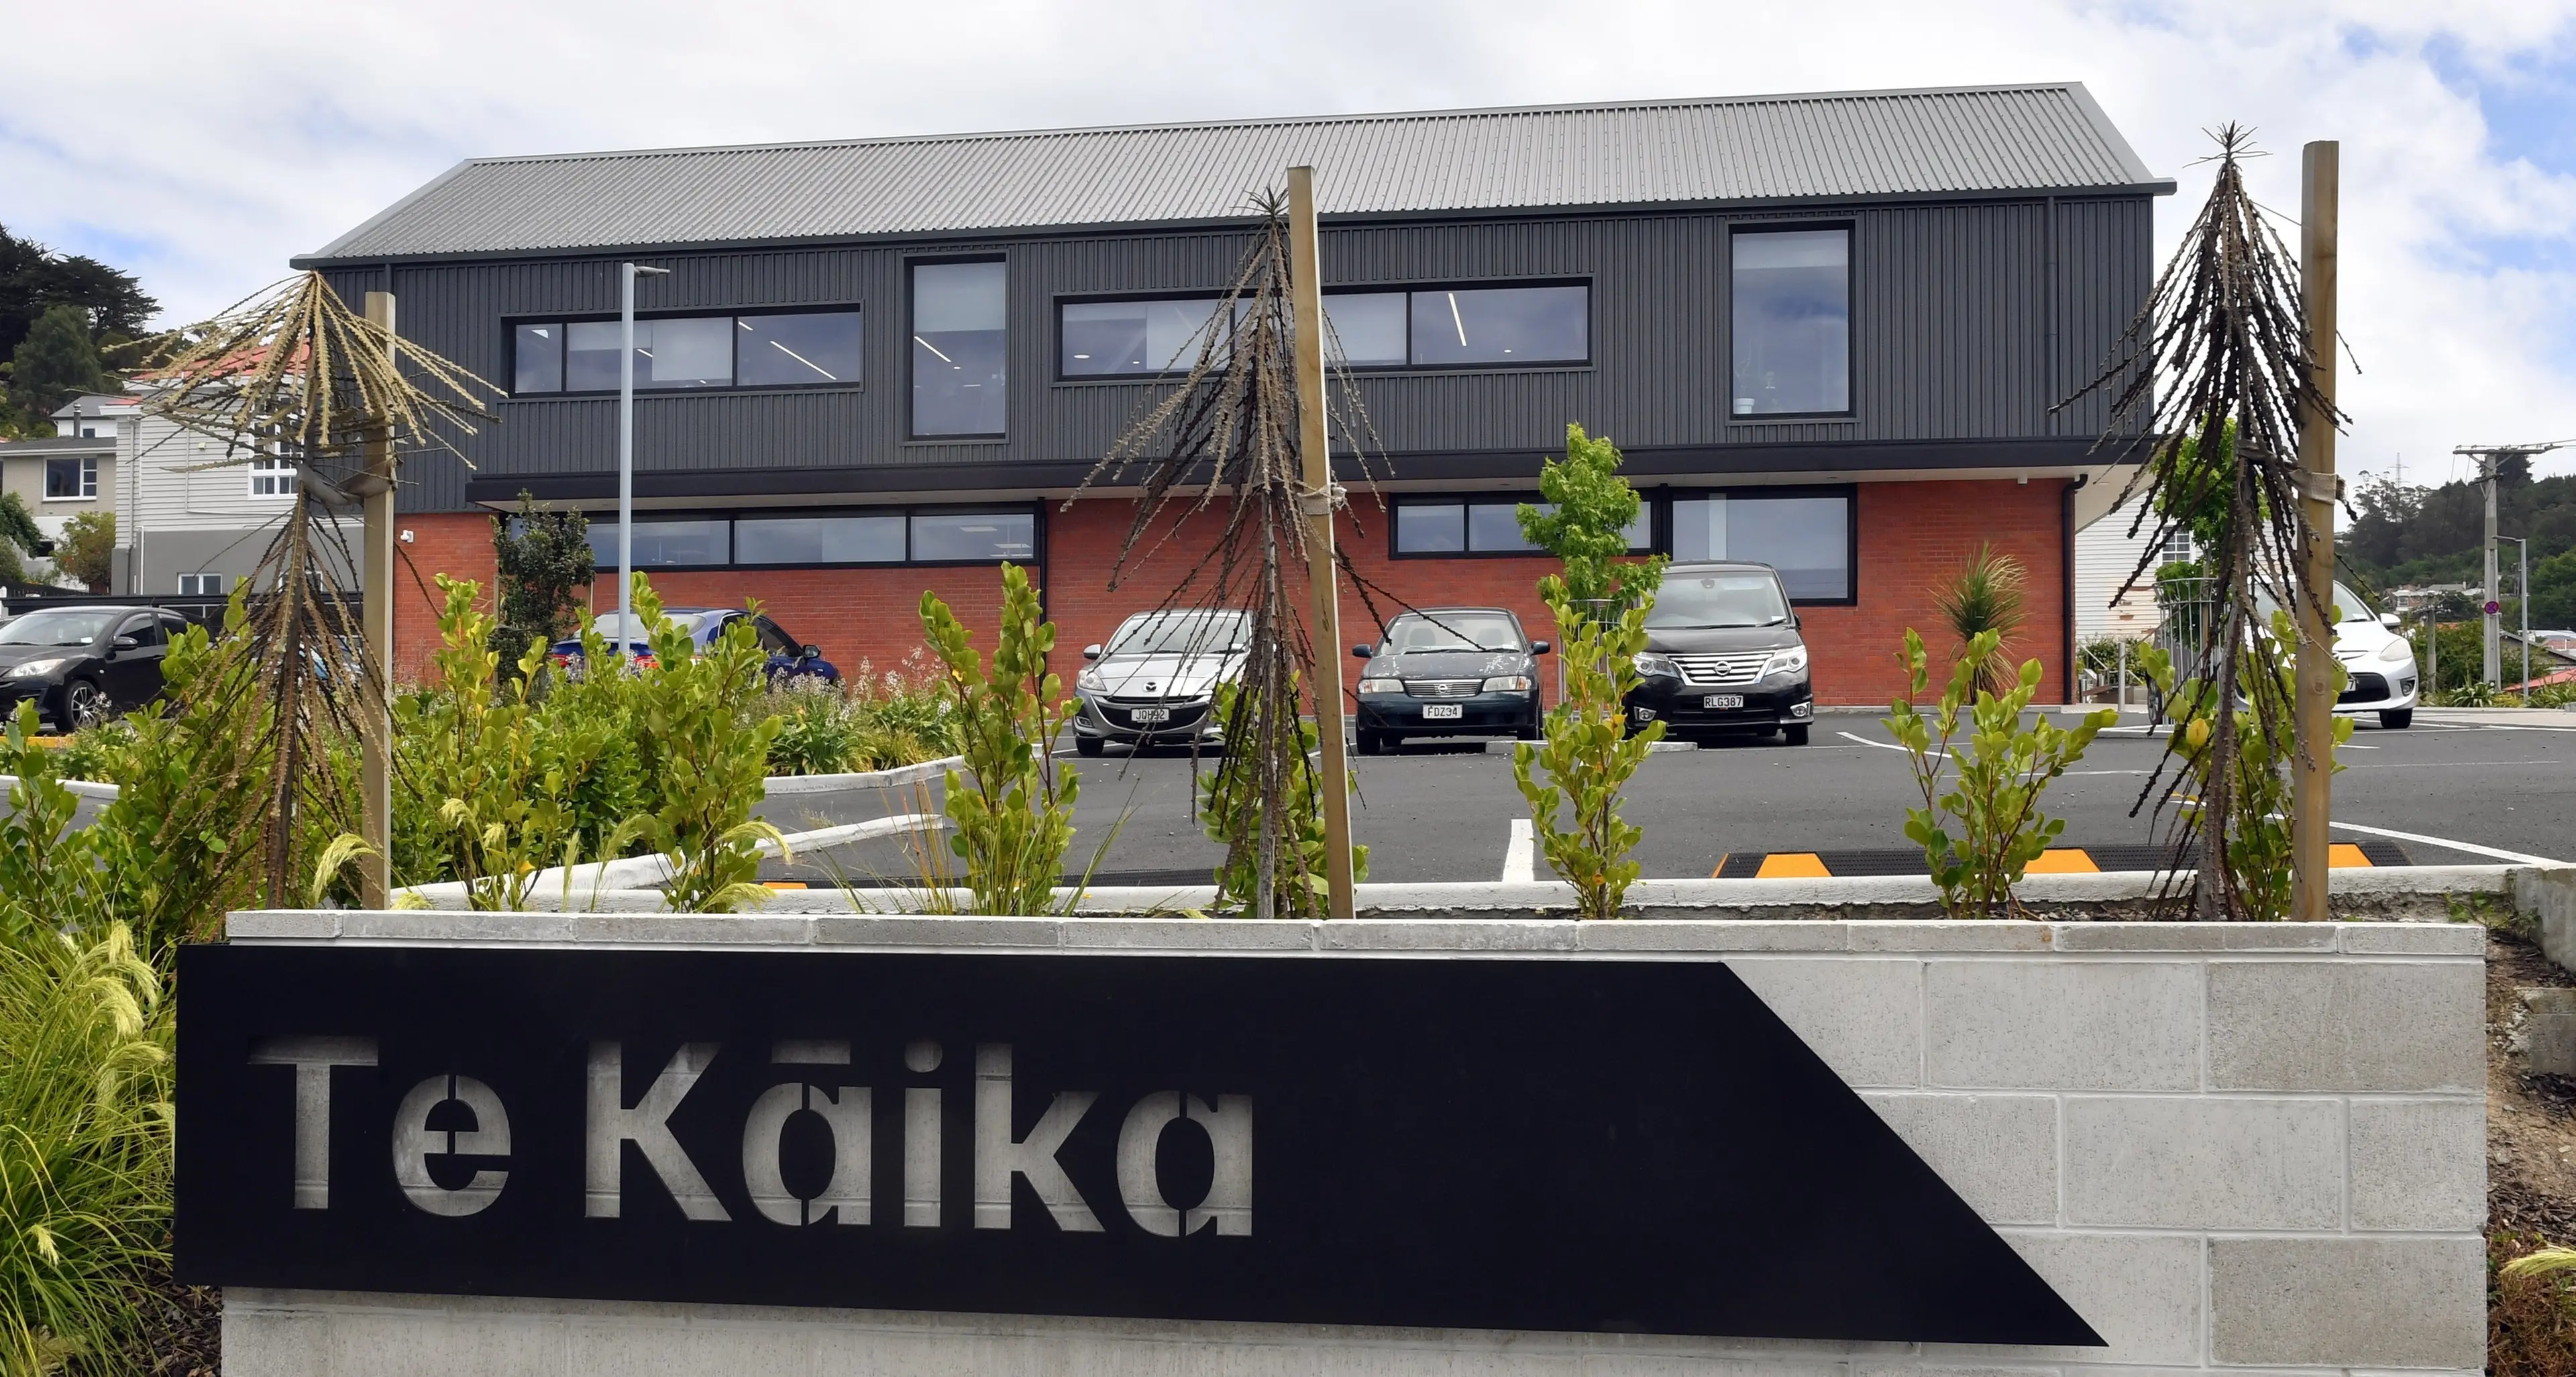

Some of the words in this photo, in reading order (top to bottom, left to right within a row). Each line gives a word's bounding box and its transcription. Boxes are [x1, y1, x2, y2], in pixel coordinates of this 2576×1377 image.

[1705, 696, 1742, 707] RLG387
[1428, 706, 1458, 717] FDZ34
[247, 1035, 511, 1217] Te
[584, 1038, 1253, 1237] Kāika
